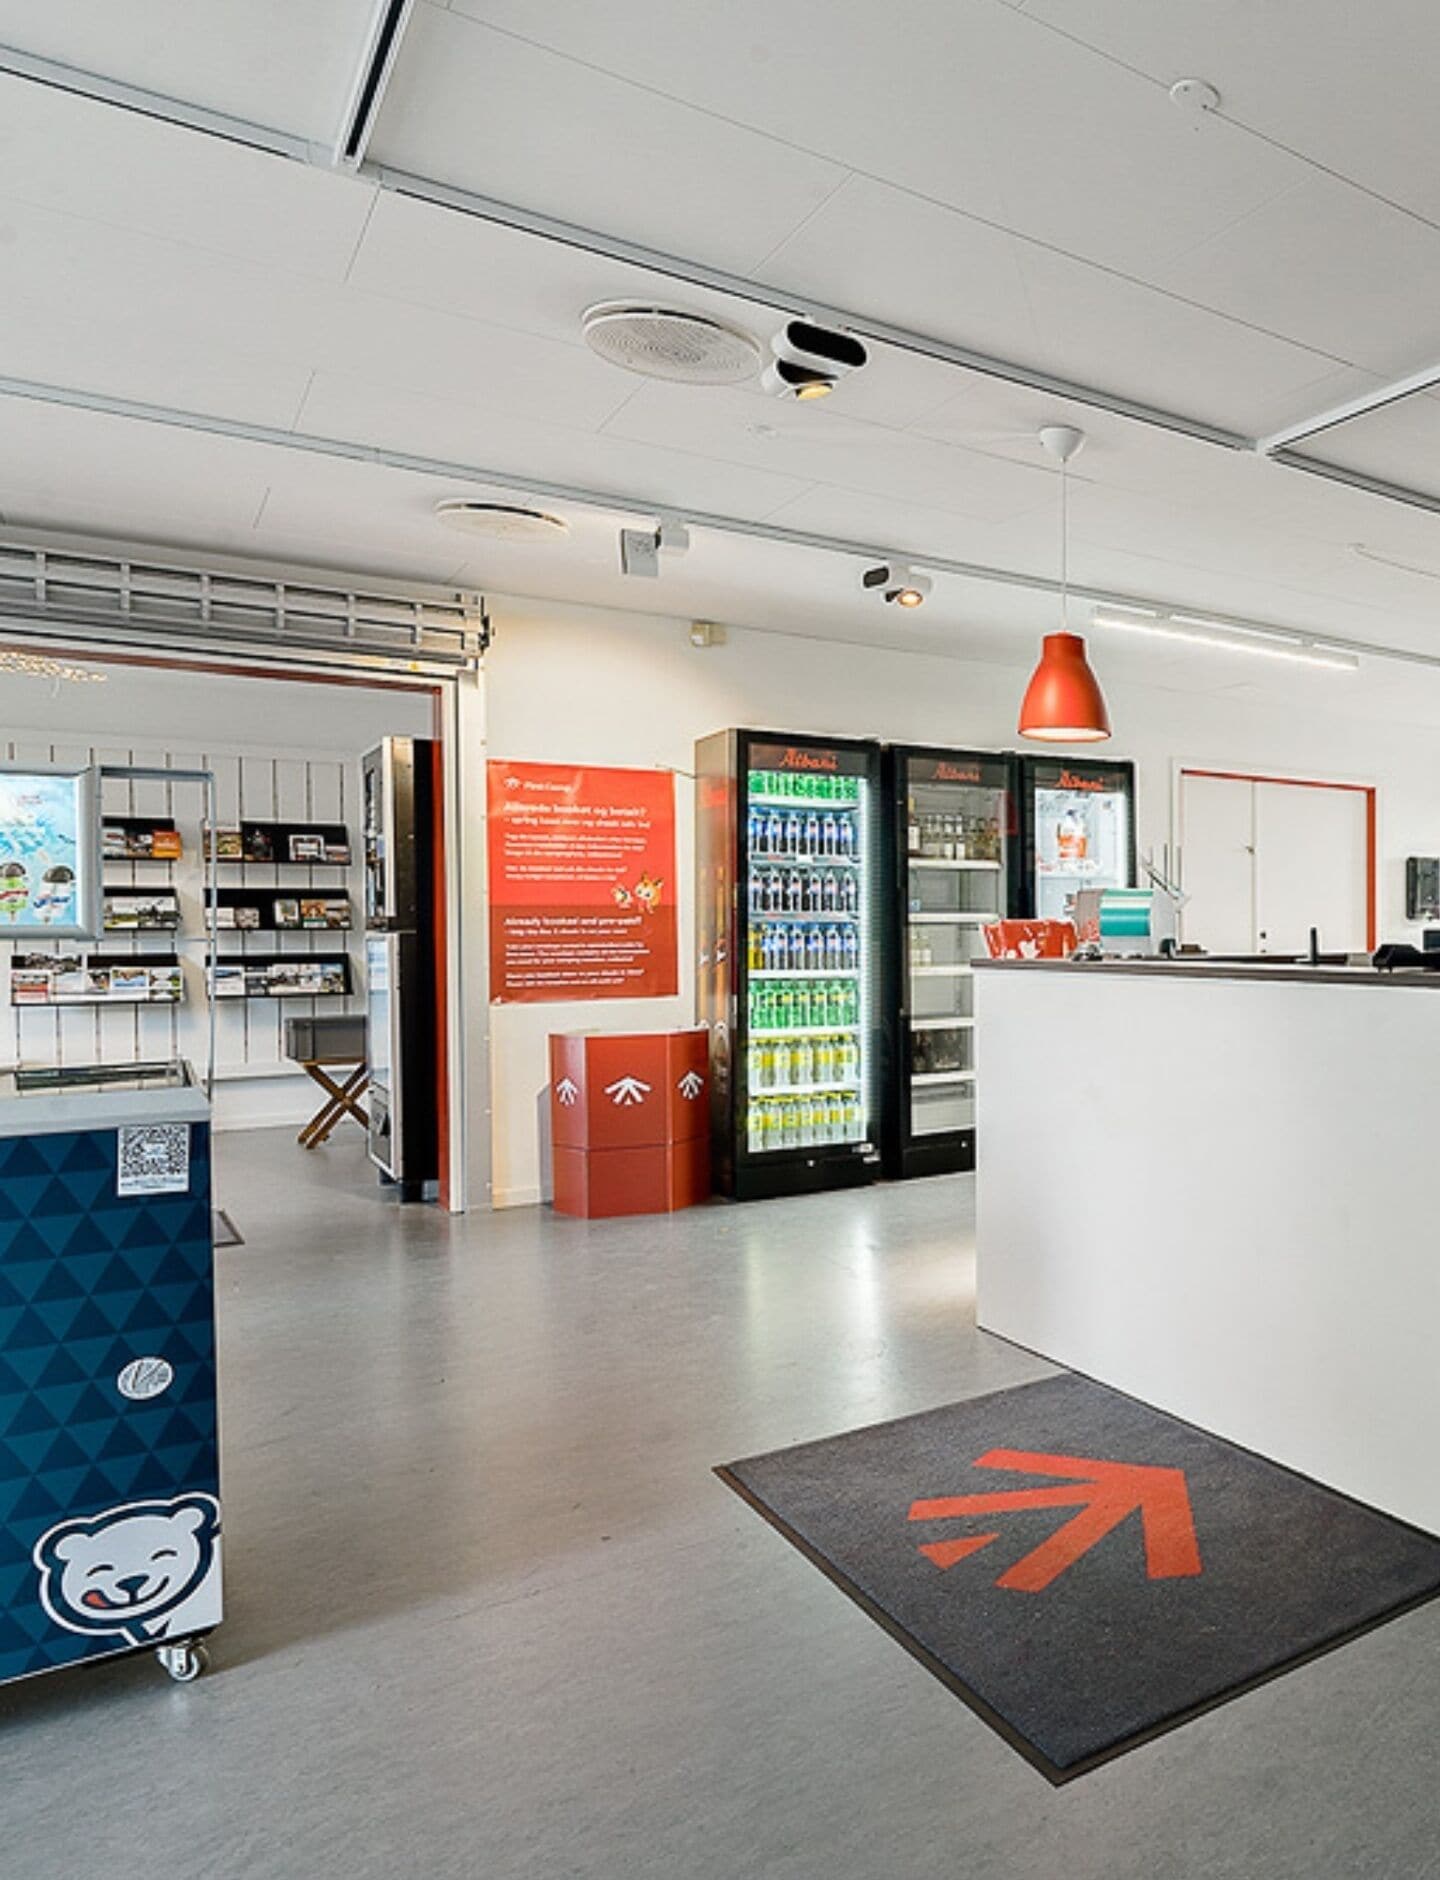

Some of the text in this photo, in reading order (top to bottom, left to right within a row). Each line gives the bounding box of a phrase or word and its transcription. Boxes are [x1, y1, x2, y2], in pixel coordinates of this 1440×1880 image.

[778, 748, 838, 771] Albani
[932, 762, 982, 784] Albani
[1054, 768, 1106, 790] Albani
